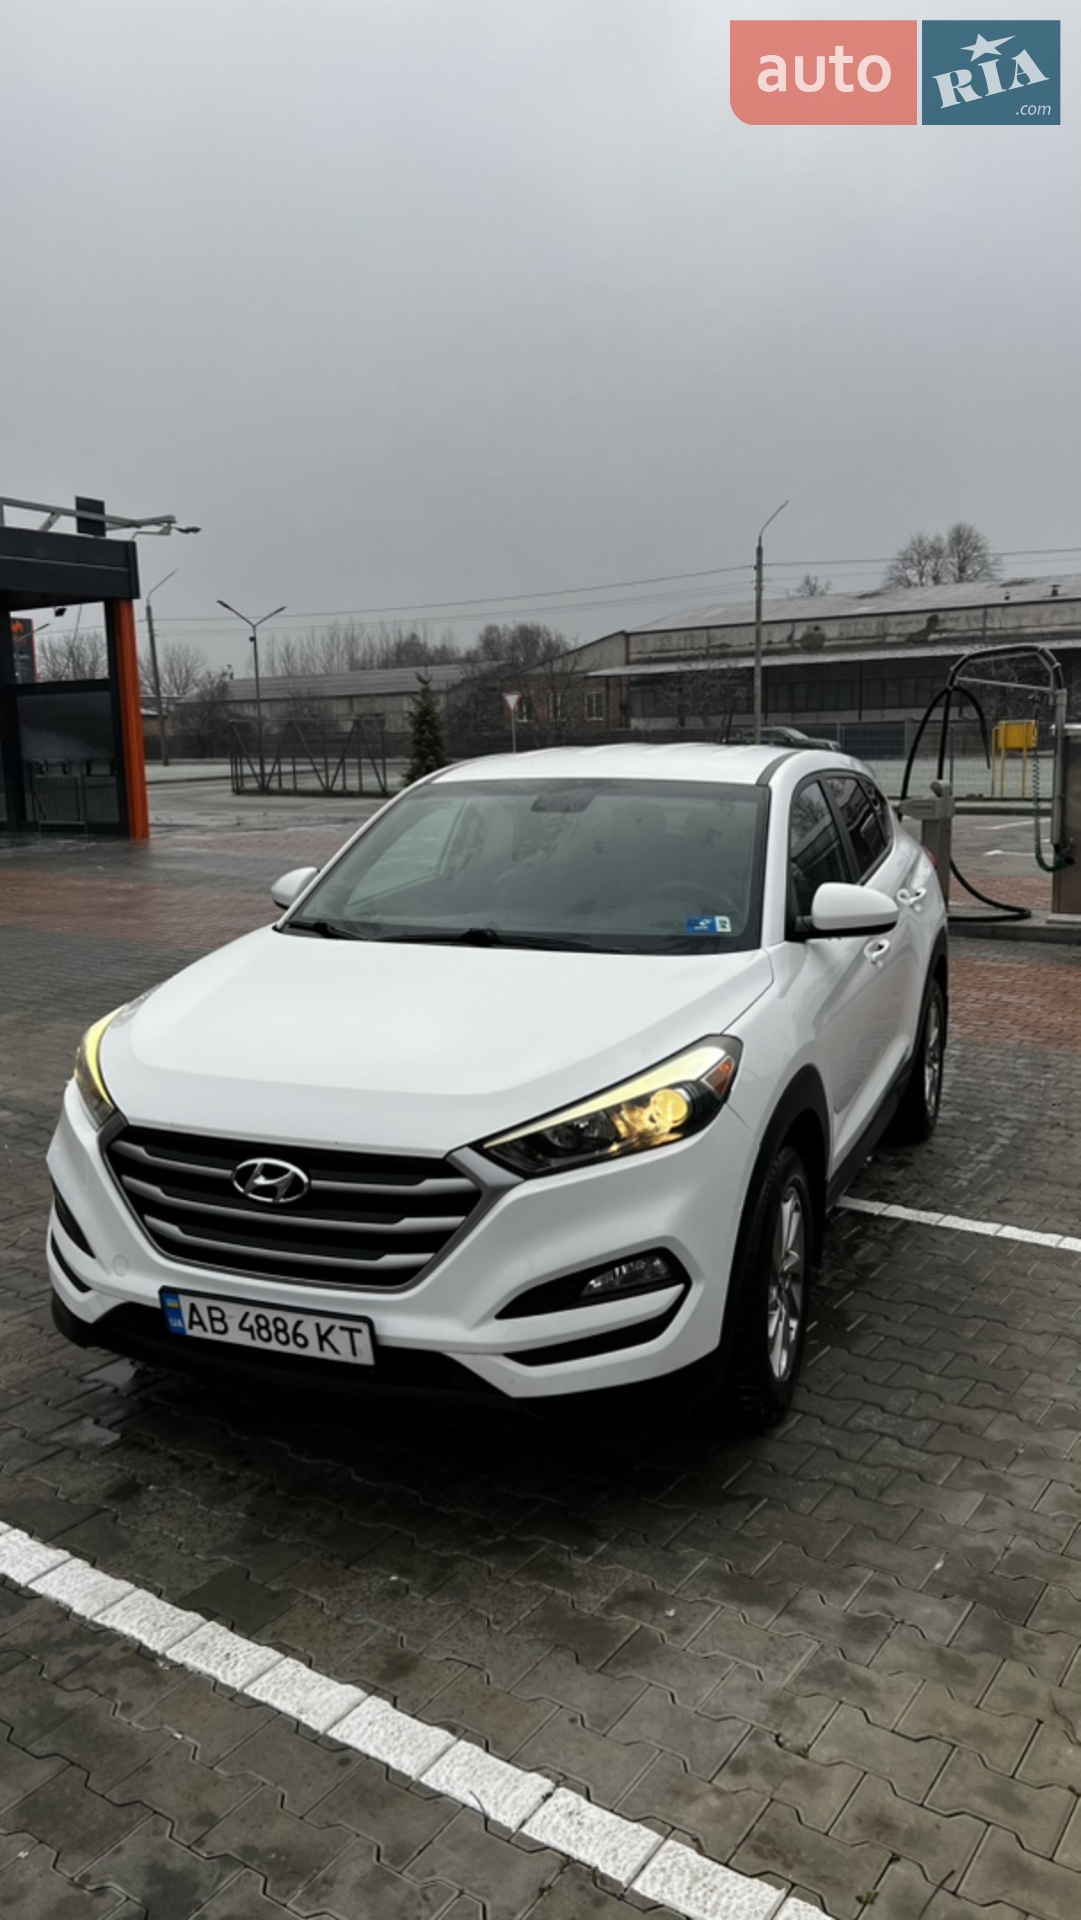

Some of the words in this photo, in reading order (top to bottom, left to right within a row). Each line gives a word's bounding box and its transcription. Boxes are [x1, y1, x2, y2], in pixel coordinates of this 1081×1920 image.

[169, 1318, 184, 1328] UA
[188, 1302, 229, 1336] AB
[238, 1311, 309, 1350] 4886
[315, 1322, 363, 1358] KT
